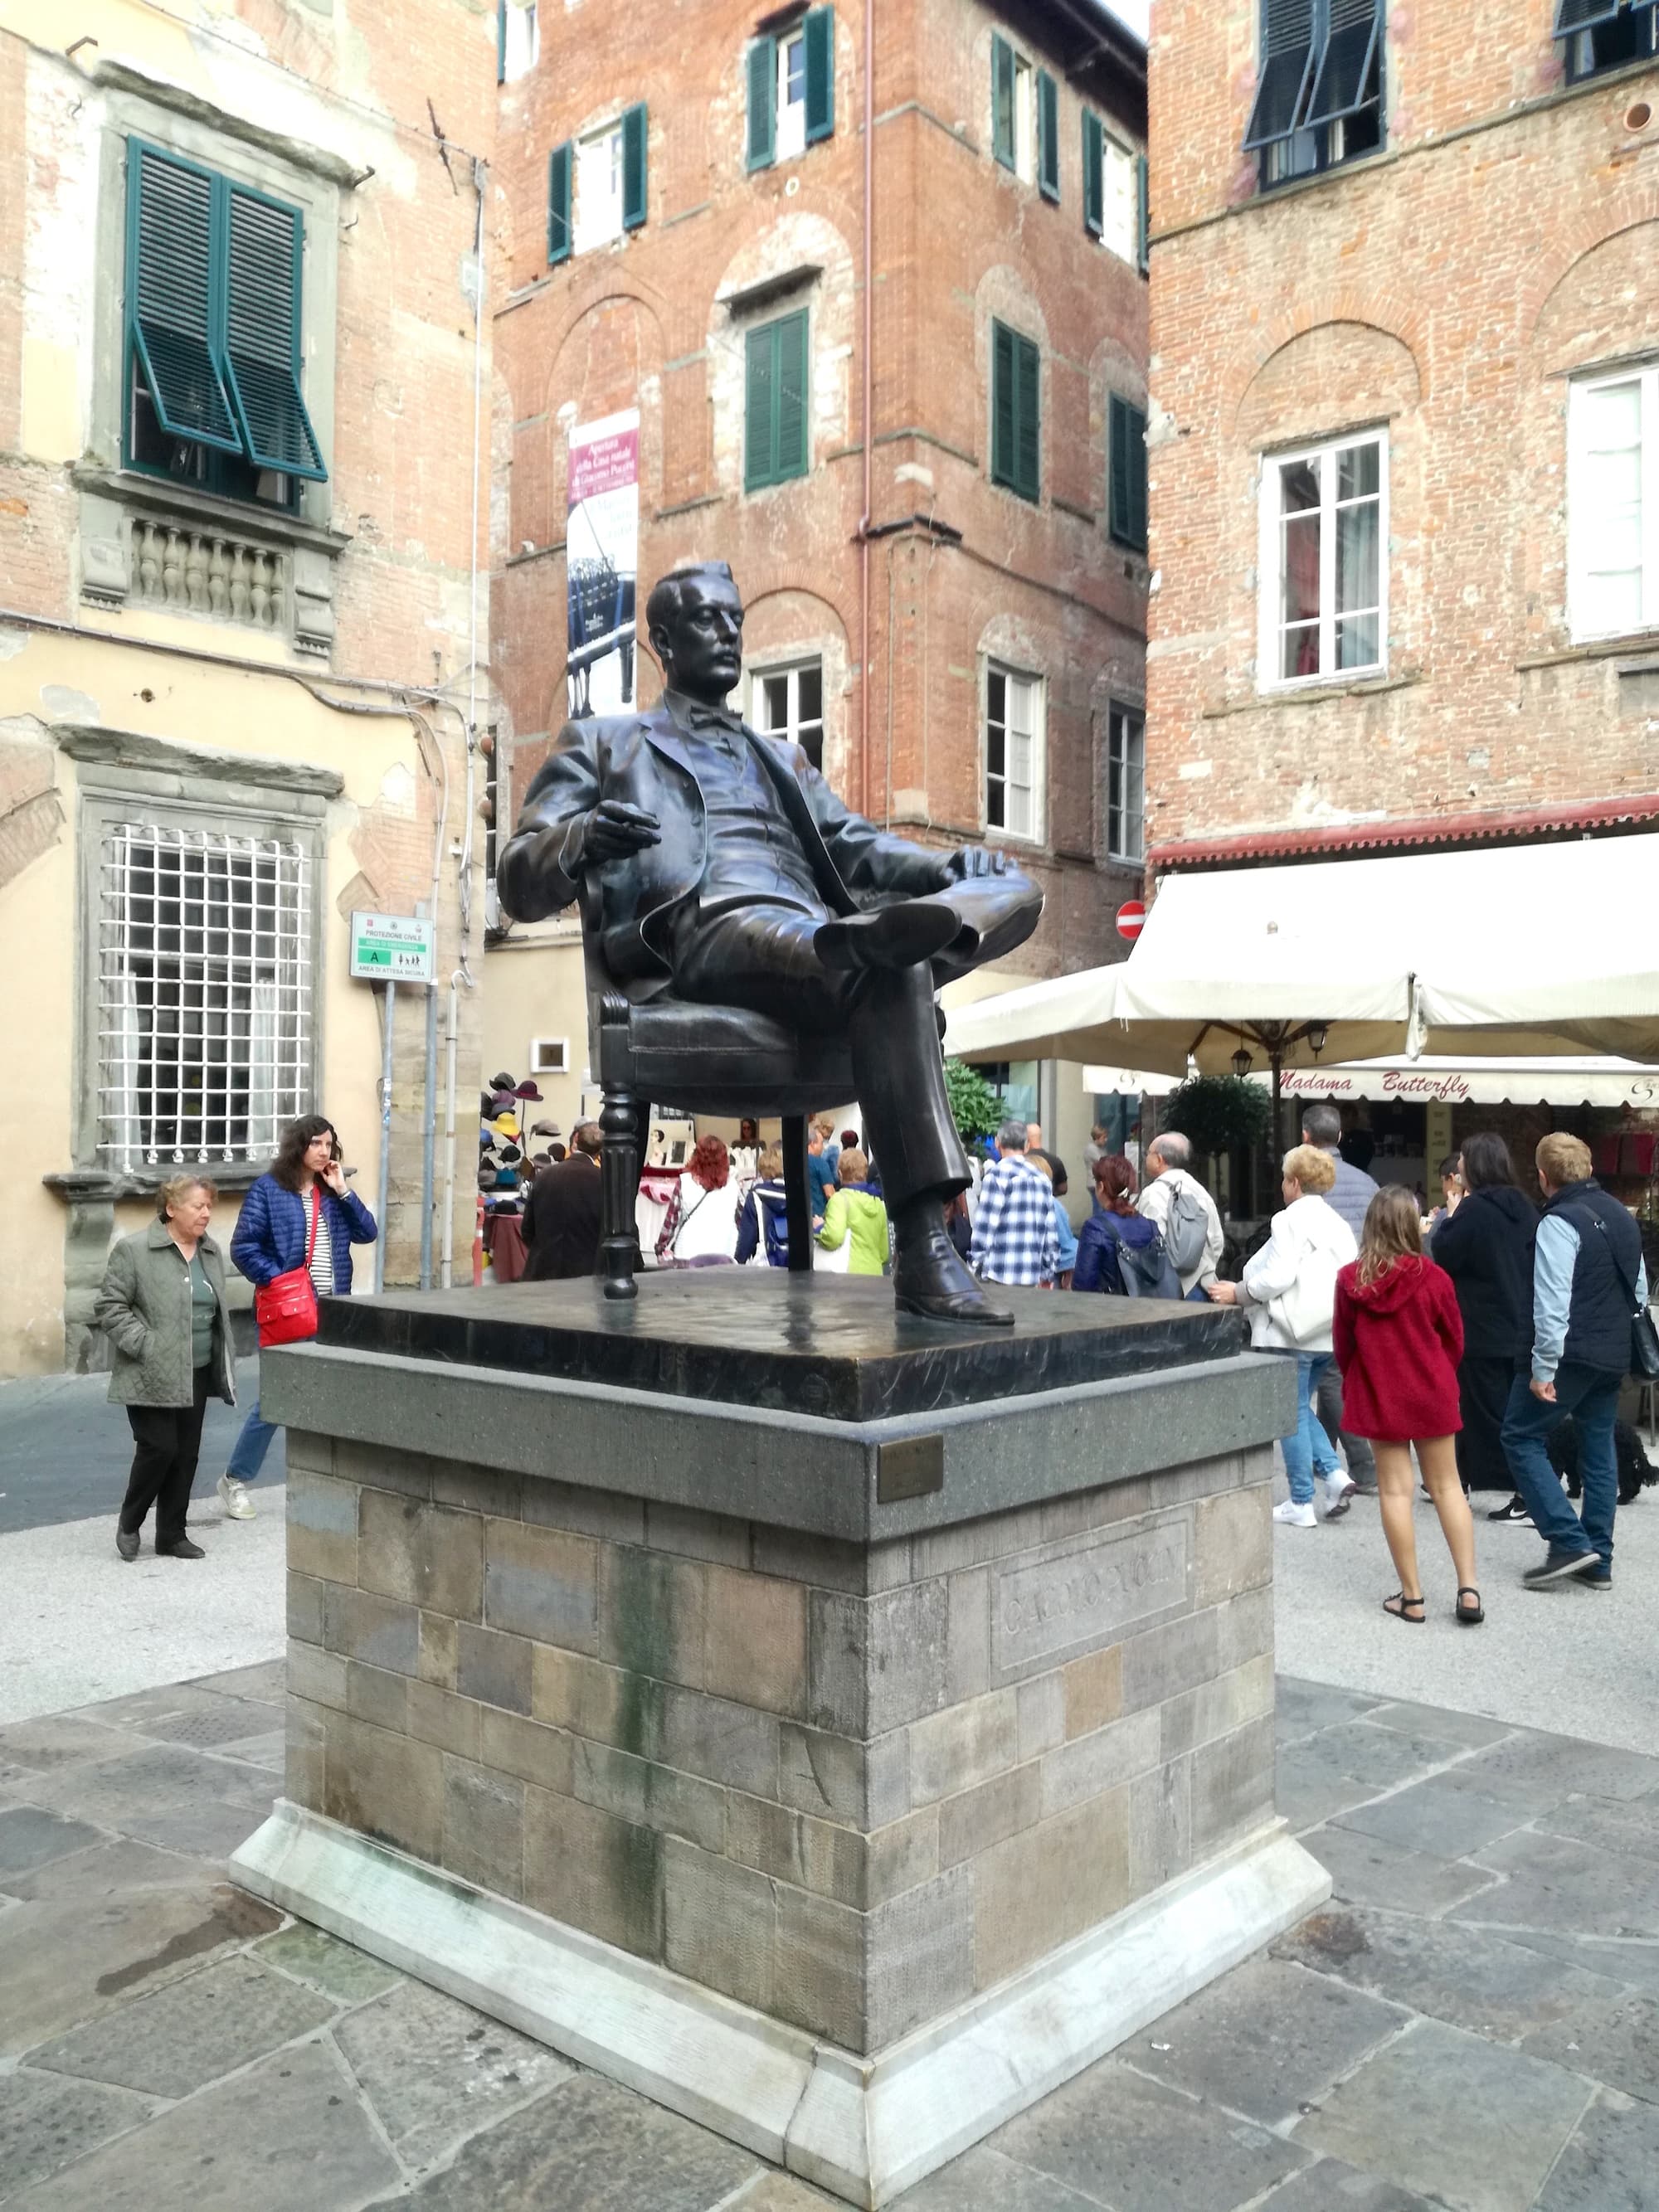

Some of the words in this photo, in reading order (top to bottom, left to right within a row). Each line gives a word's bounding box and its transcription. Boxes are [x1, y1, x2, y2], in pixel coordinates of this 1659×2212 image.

[588, 439, 618, 457] Apertura
[366, 930, 402, 939] PROTEZIONE
[370, 951, 379, 962] A
[1279, 1069, 1353, 1090] Madama
[1383, 1071, 1470, 1100] Butterfly
